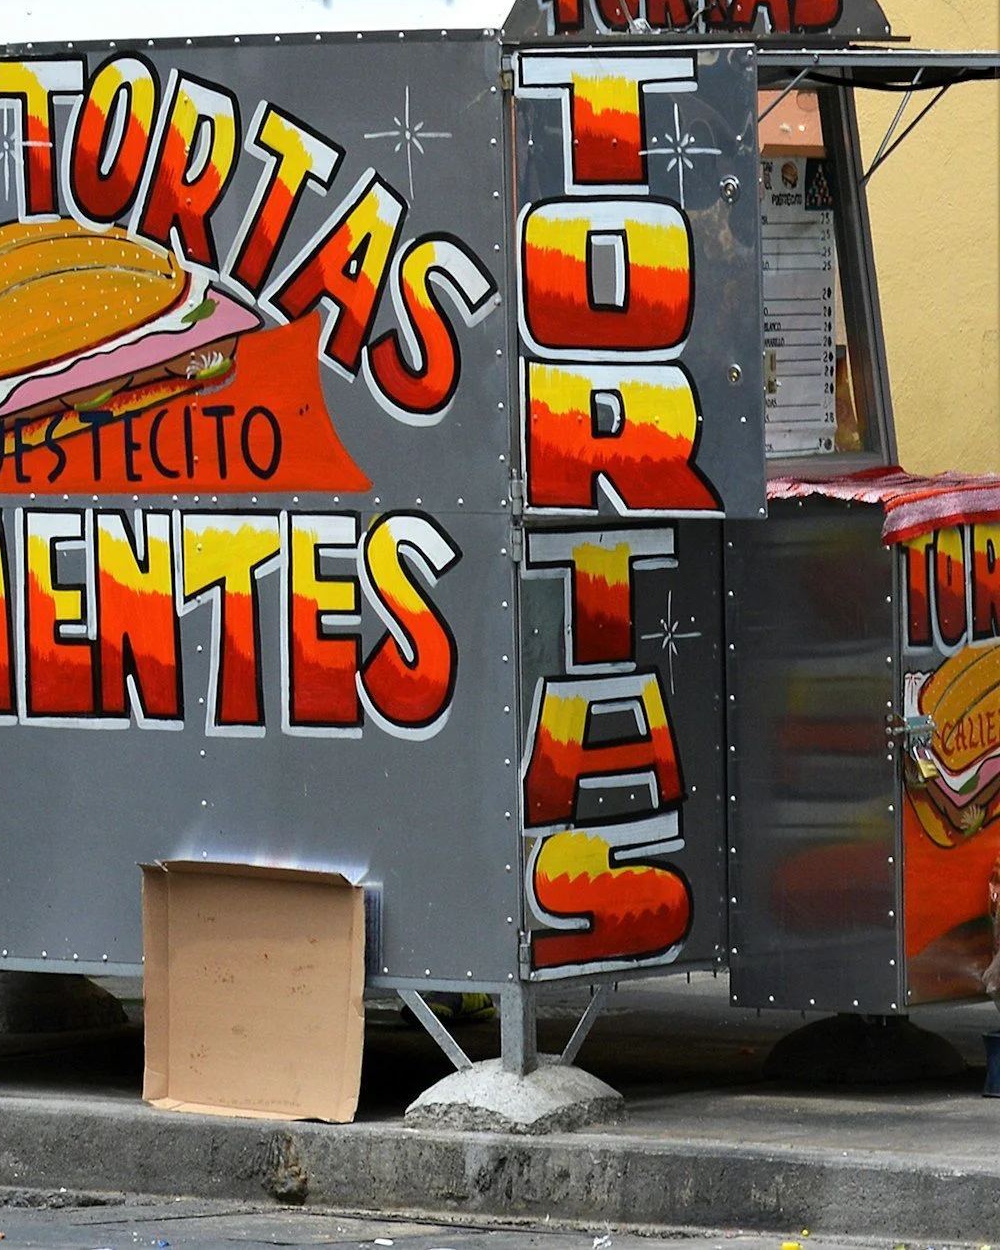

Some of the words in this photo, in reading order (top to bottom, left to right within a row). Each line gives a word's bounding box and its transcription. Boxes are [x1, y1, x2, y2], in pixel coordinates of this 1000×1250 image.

[823, 351, 834, 363] 20
[824, 365, 834, 377] 20
[824, 382, 834, 395] 20
[514, 50, 725, 982] TORTAS
[941, 710, 1000, 756] CALIE
